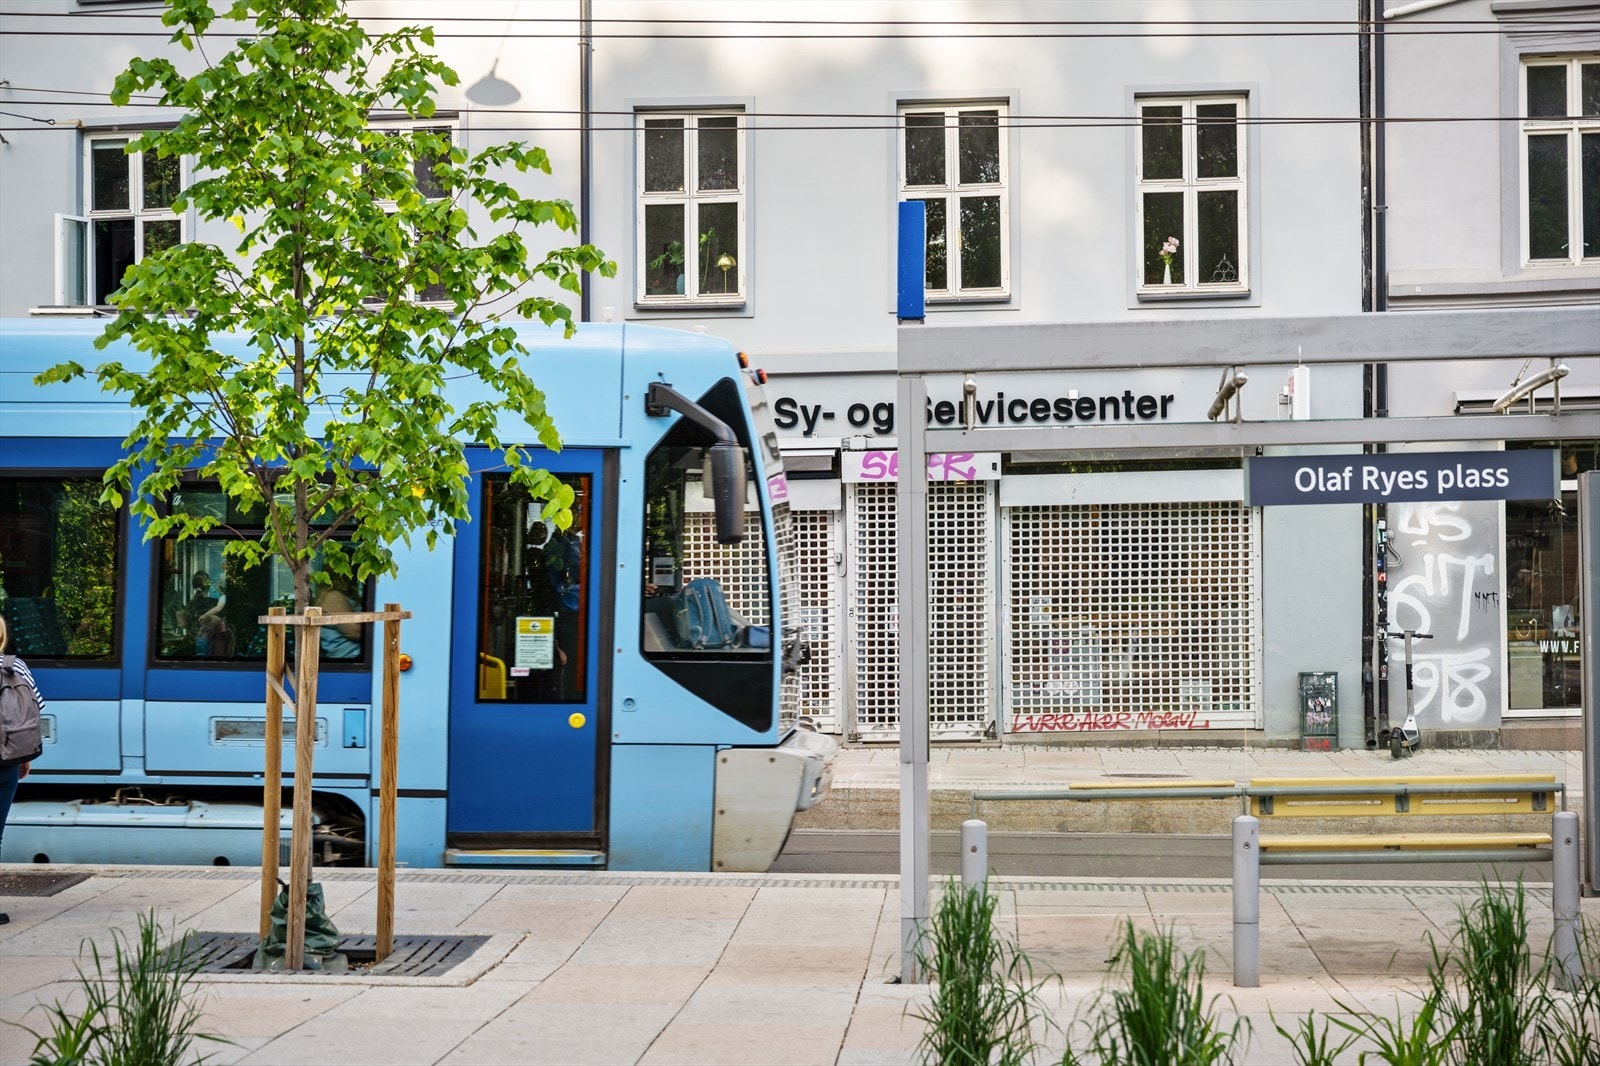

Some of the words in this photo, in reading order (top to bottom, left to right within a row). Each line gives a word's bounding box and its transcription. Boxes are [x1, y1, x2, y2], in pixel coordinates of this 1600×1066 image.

[773, 397, 835, 435] Sy-
[847, 401, 894, 434] og
[1294, 466, 1354, 492] Olaf
[1362, 465, 1428, 496] Ryes
[1437, 463, 1509, 494] plass
